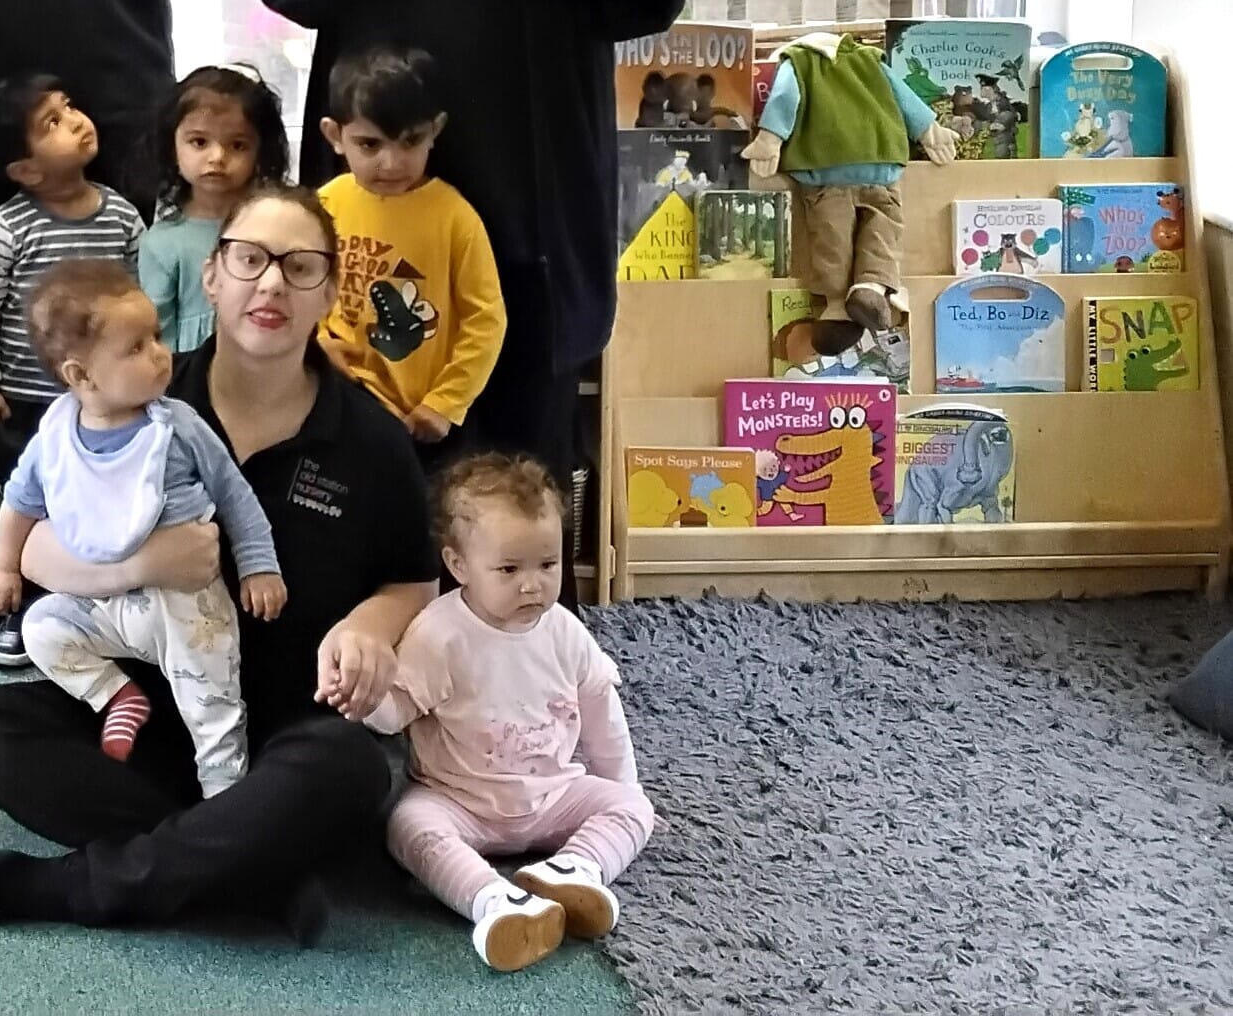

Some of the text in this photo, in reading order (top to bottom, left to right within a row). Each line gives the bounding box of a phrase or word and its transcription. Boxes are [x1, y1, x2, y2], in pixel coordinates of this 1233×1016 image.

[672, 49, 693, 65] THE
[695, 33, 747, 72] LOO?
[911, 41, 959, 56] Charlie
[926, 57, 992, 70] Favourite
[941, 70, 971, 81] Book
[665, 213, 687, 226] The
[973, 213, 1046, 229] COLOURS
[947, 305, 982, 321] Ted,
[987, 305, 1007, 321] Bo
[1022, 305, 1050, 321] Diz
[1088, 305, 1097, 319] MY
[1099, 301, 1195, 344] SNAP
[741, 391, 815, 412] Let's Play
[738, 411, 823, 437] MONSTERS!
[902, 442, 957, 454] BIGGEST
[634, 453, 743, 470] Spot Says Please
[897, 455, 948, 465] INOSAURS
